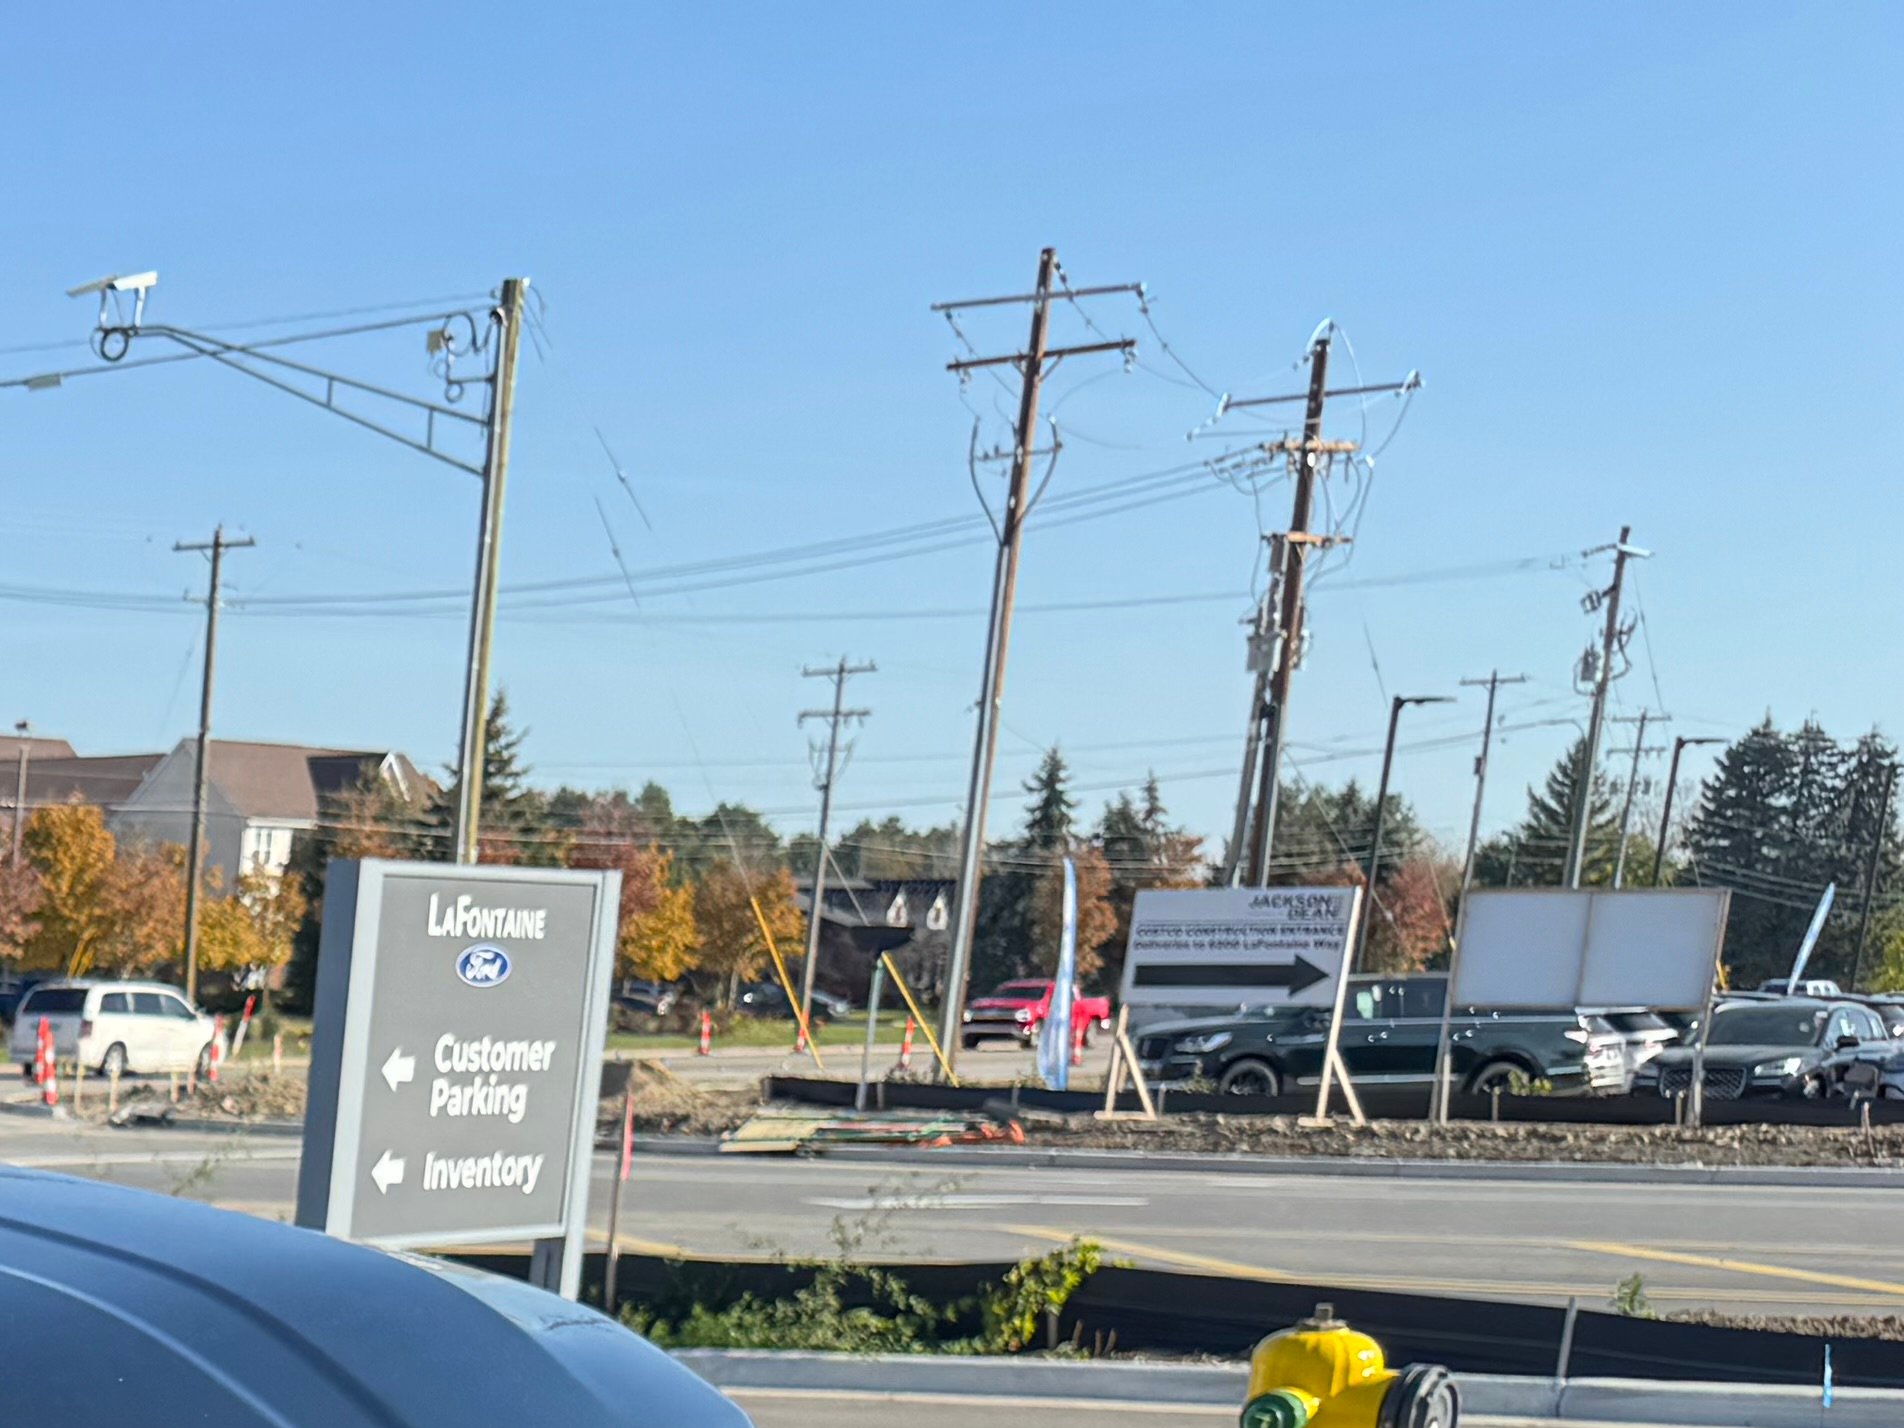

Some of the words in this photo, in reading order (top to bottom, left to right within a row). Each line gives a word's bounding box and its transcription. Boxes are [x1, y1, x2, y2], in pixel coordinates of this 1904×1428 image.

[1248, 894, 1333, 909] JACKSON
[1288, 907, 1340, 921] DEAN
[433, 1033, 556, 1073] Customer
[428, 1074, 529, 1124] Parking
[423, 1150, 545, 1195] Inventory
